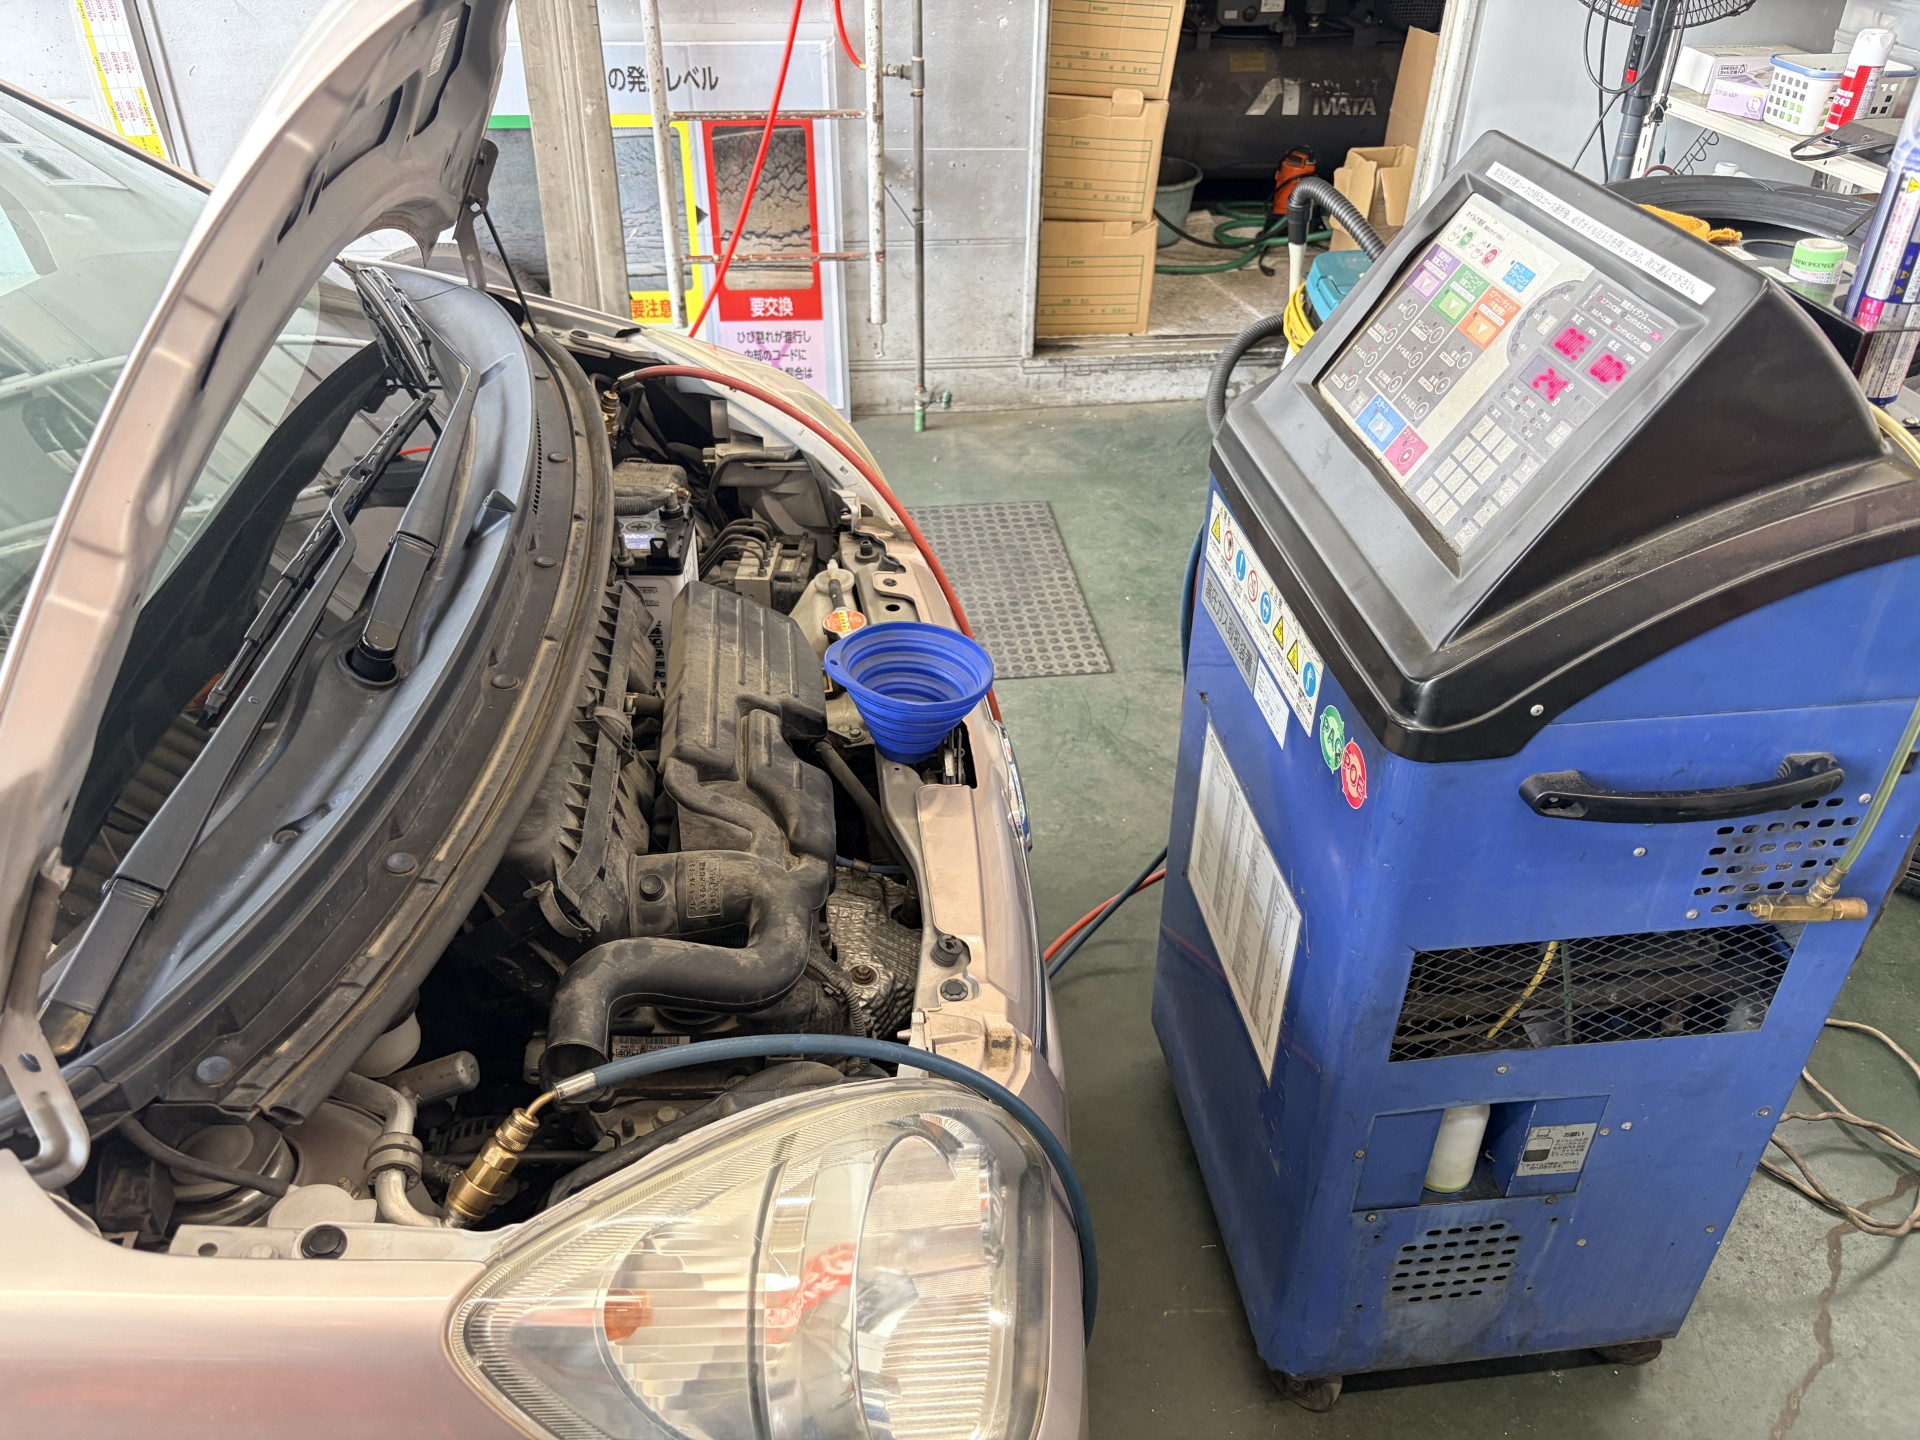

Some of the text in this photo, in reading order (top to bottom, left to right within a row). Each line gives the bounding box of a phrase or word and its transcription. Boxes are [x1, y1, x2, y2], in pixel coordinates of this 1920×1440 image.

[608, 66, 719, 92] の発レベル
[1312, 97, 1376, 116] IWATA
[749, 297, 793, 317] 要交換
[737, 331, 811, 345] ひび割れが進行し
[1374, 397, 1390, 414] スタート
[1401, 427, 1418, 446] ストップ
[1322, 714, 1343, 755] PAG
[1343, 749, 1366, 801] POE
